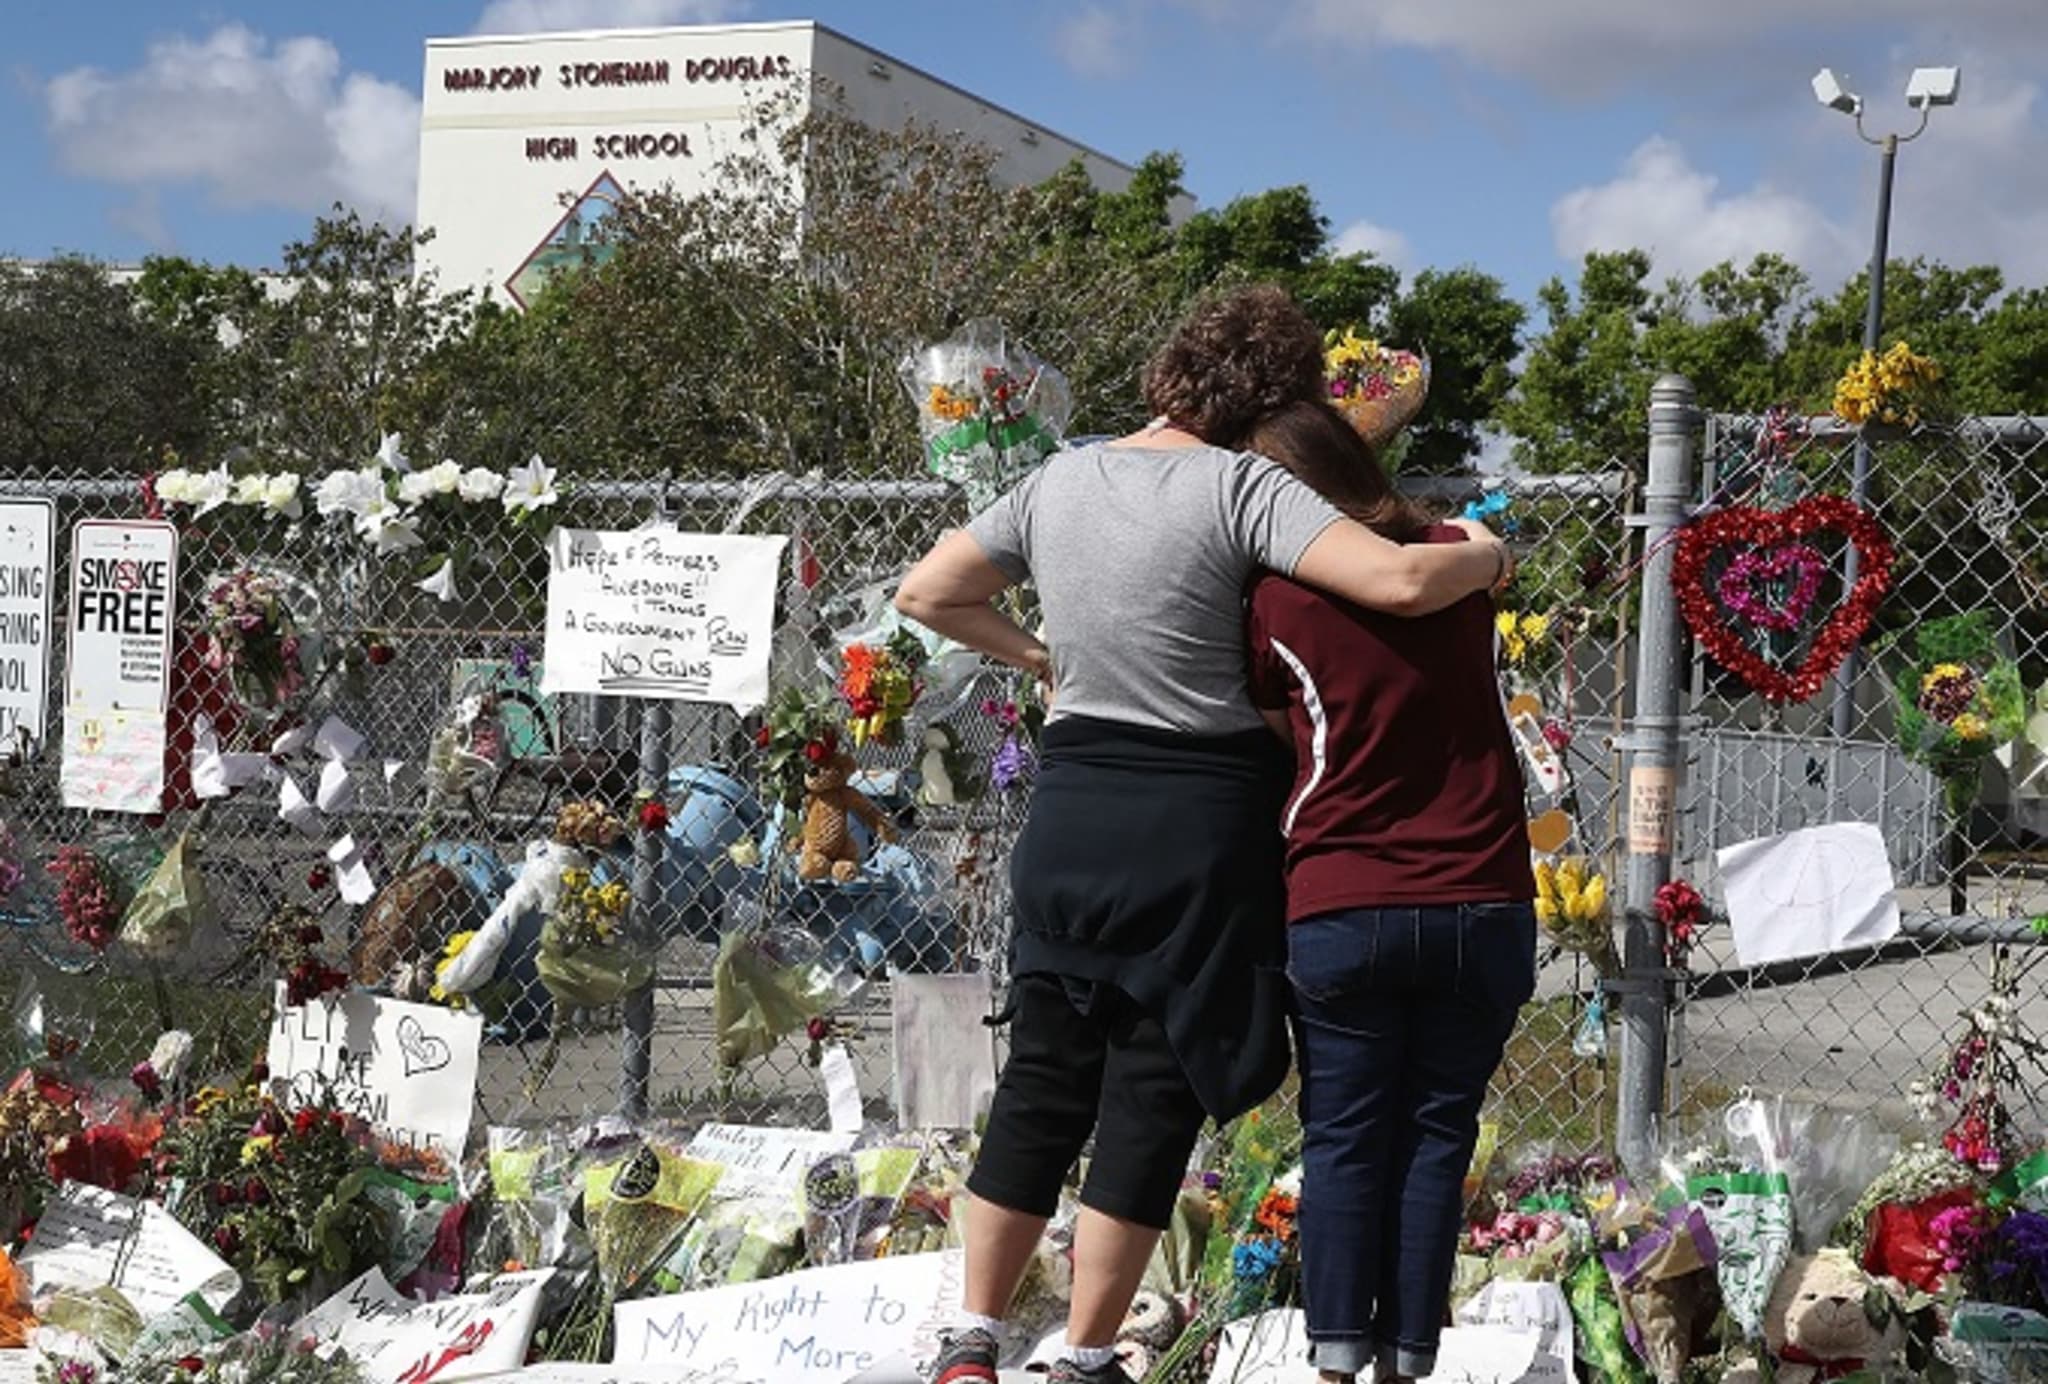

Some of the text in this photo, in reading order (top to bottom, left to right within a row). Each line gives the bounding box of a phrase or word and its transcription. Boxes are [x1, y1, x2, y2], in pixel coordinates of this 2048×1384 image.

[444, 55, 792, 92] MARJORY STONEMAN DOUGLAS
[525, 133, 693, 161] HIGH SCHOOL
[77, 591, 164, 635] FREE
[600, 647, 642, 676] NO
[641, 1283, 907, 1361] My Right to
[775, 1335, 873, 1371] More
